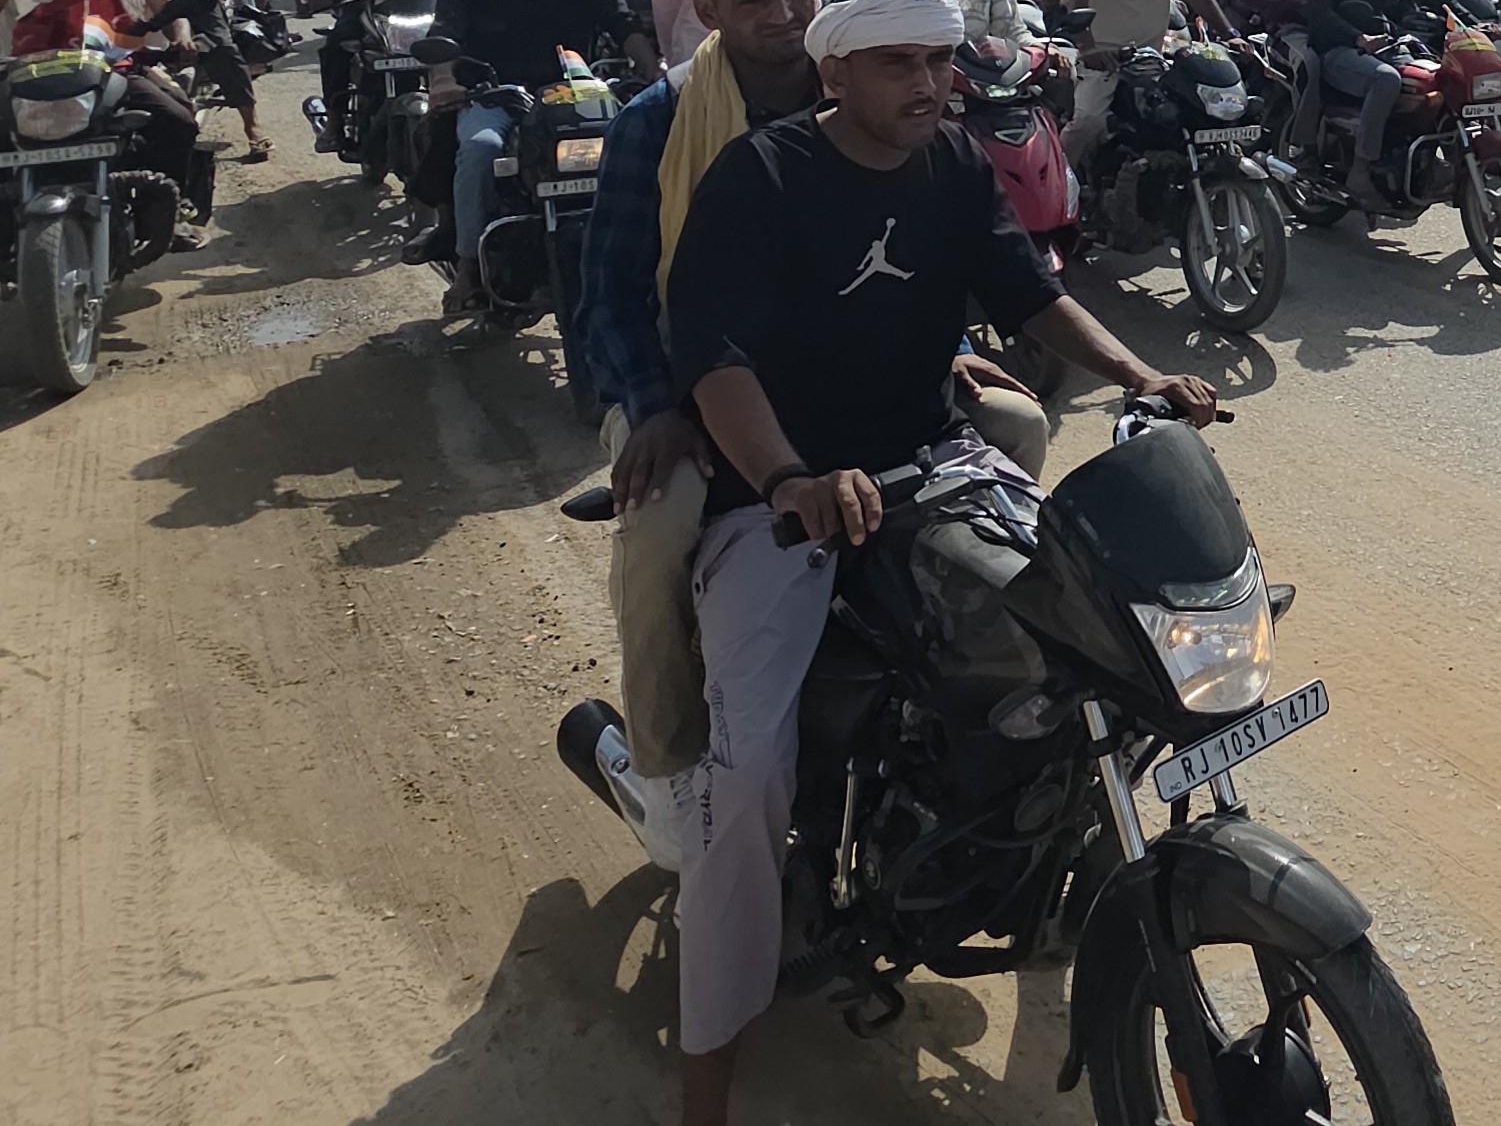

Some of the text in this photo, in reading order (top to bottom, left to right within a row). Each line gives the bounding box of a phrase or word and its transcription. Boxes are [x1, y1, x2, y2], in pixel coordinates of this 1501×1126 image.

[1181, 687, 1319, 783] RJ 10SV 1477
